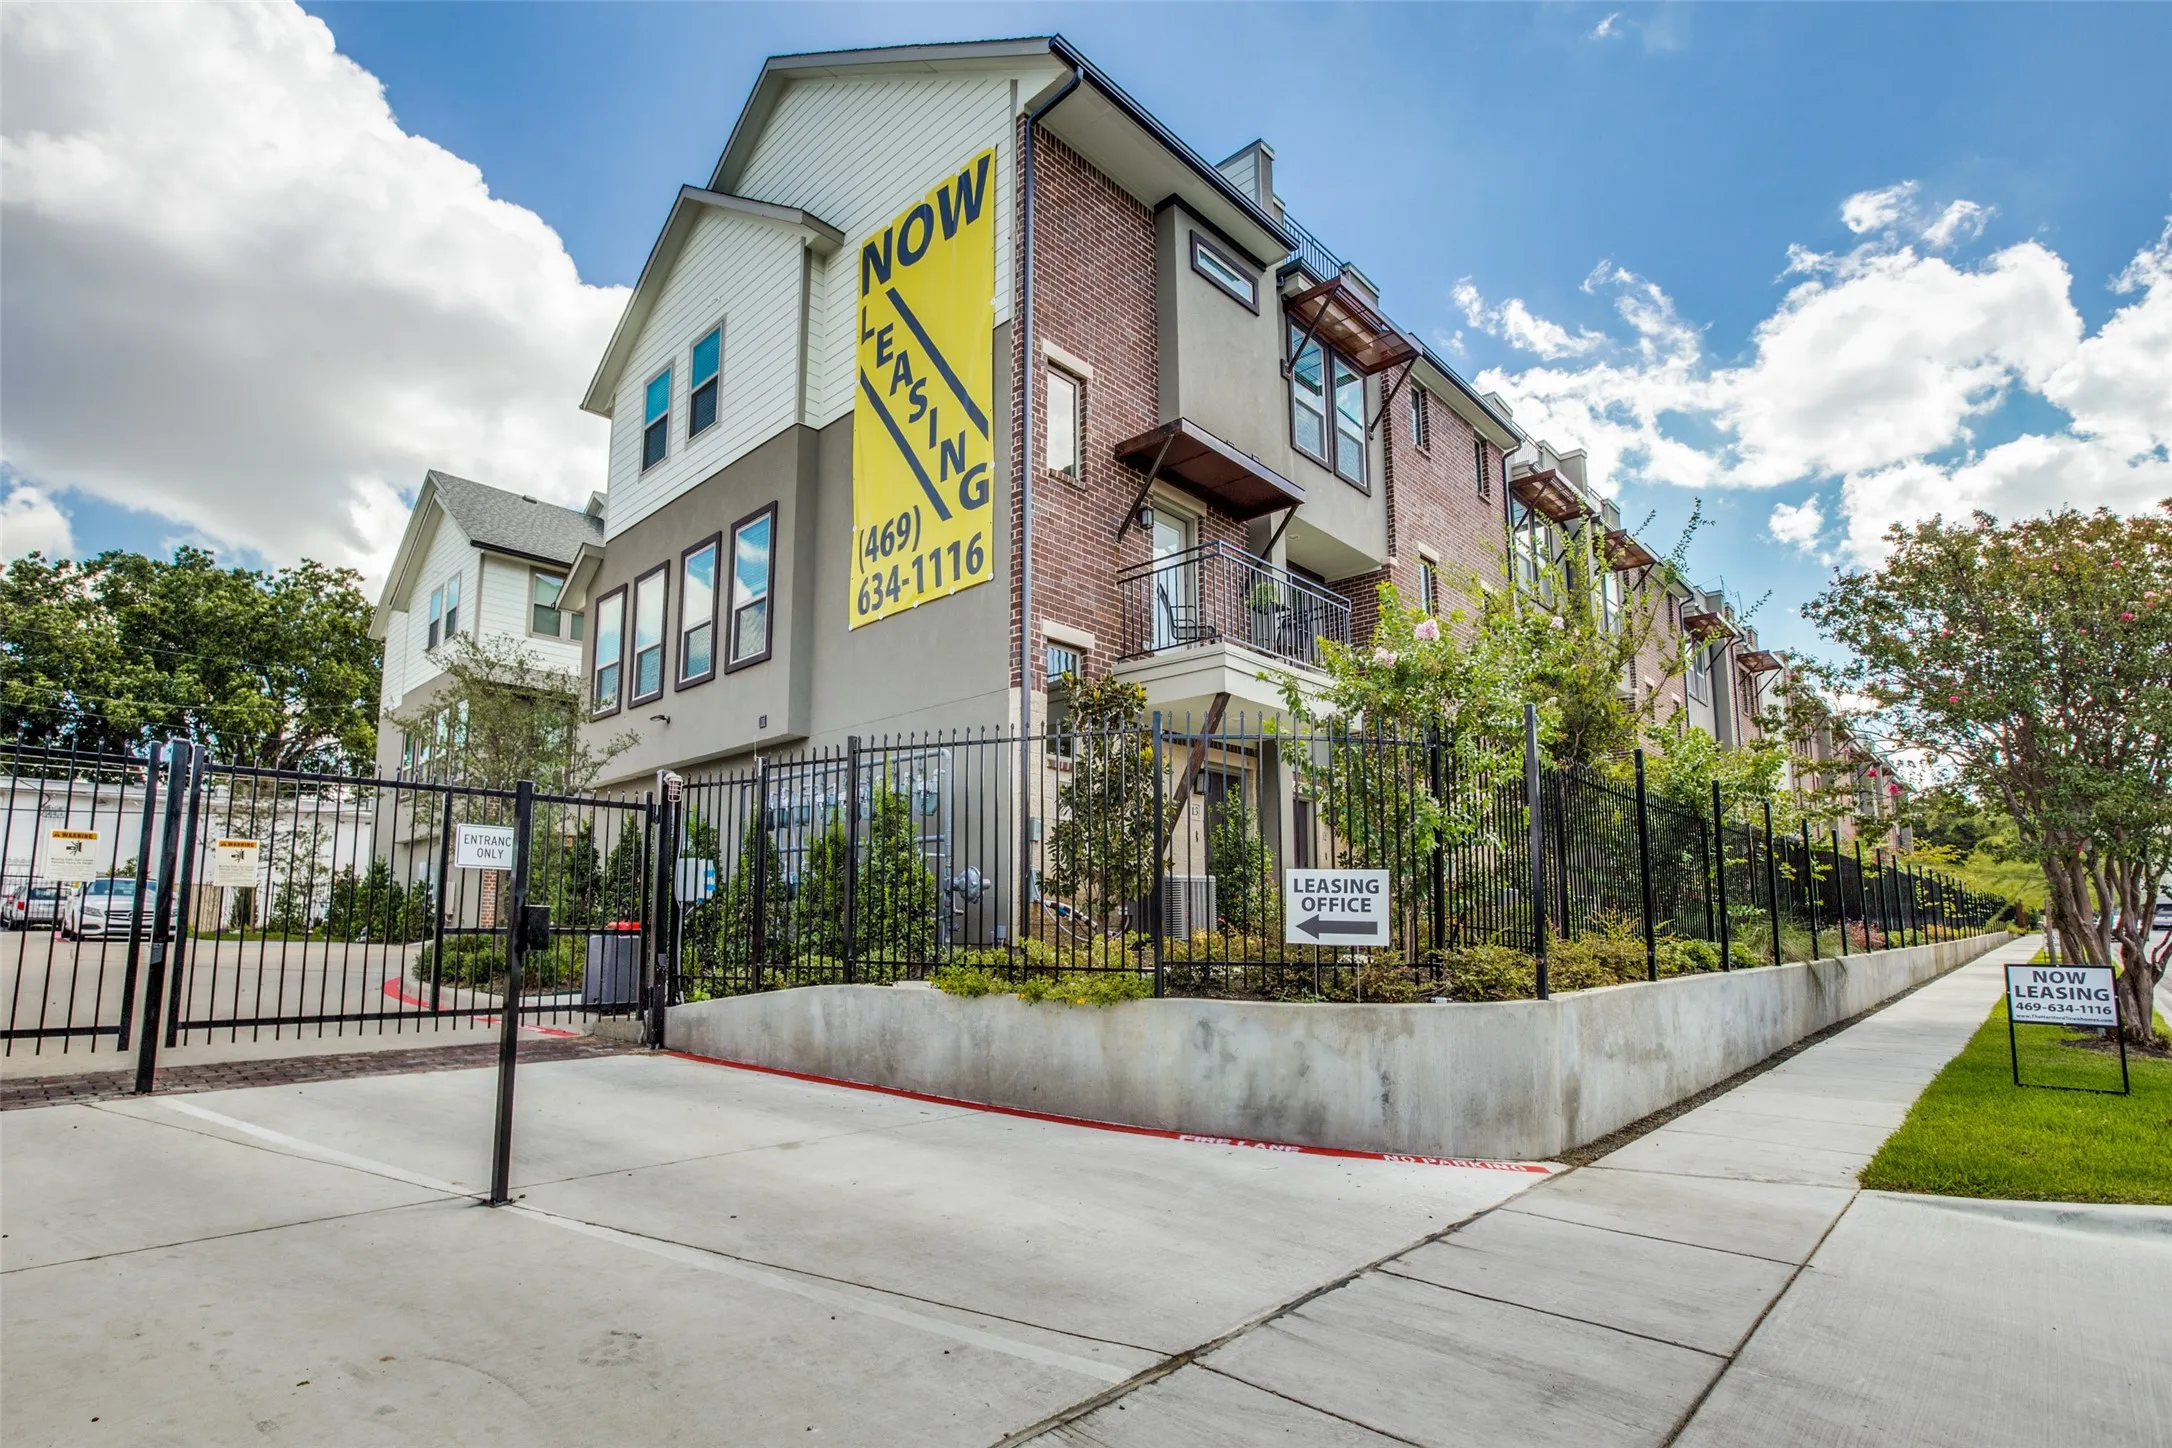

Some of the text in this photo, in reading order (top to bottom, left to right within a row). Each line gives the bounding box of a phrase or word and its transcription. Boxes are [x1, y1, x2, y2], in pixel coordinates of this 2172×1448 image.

[862, 154, 991, 297] NOW
[861, 306, 989, 510] LEASING
[859, 505, 921, 574] (469)
[857, 531, 984, 615] 634-1116
[464, 834, 512, 847] ENTRANC
[477, 848, 504, 859] ONLY
[1294, 878, 1379, 894] LEASING
[1301, 897, 1371, 912] OFFICE
[2032, 971, 2086, 984] NOW
[2015, 985, 2110, 1001] LEASING
[2015, 1002, 2112, 1015] 469-634-1116
[1180, 1134, 1302, 1152] FIRE LANE
[1383, 1154, 1528, 1172] NO PARKING
